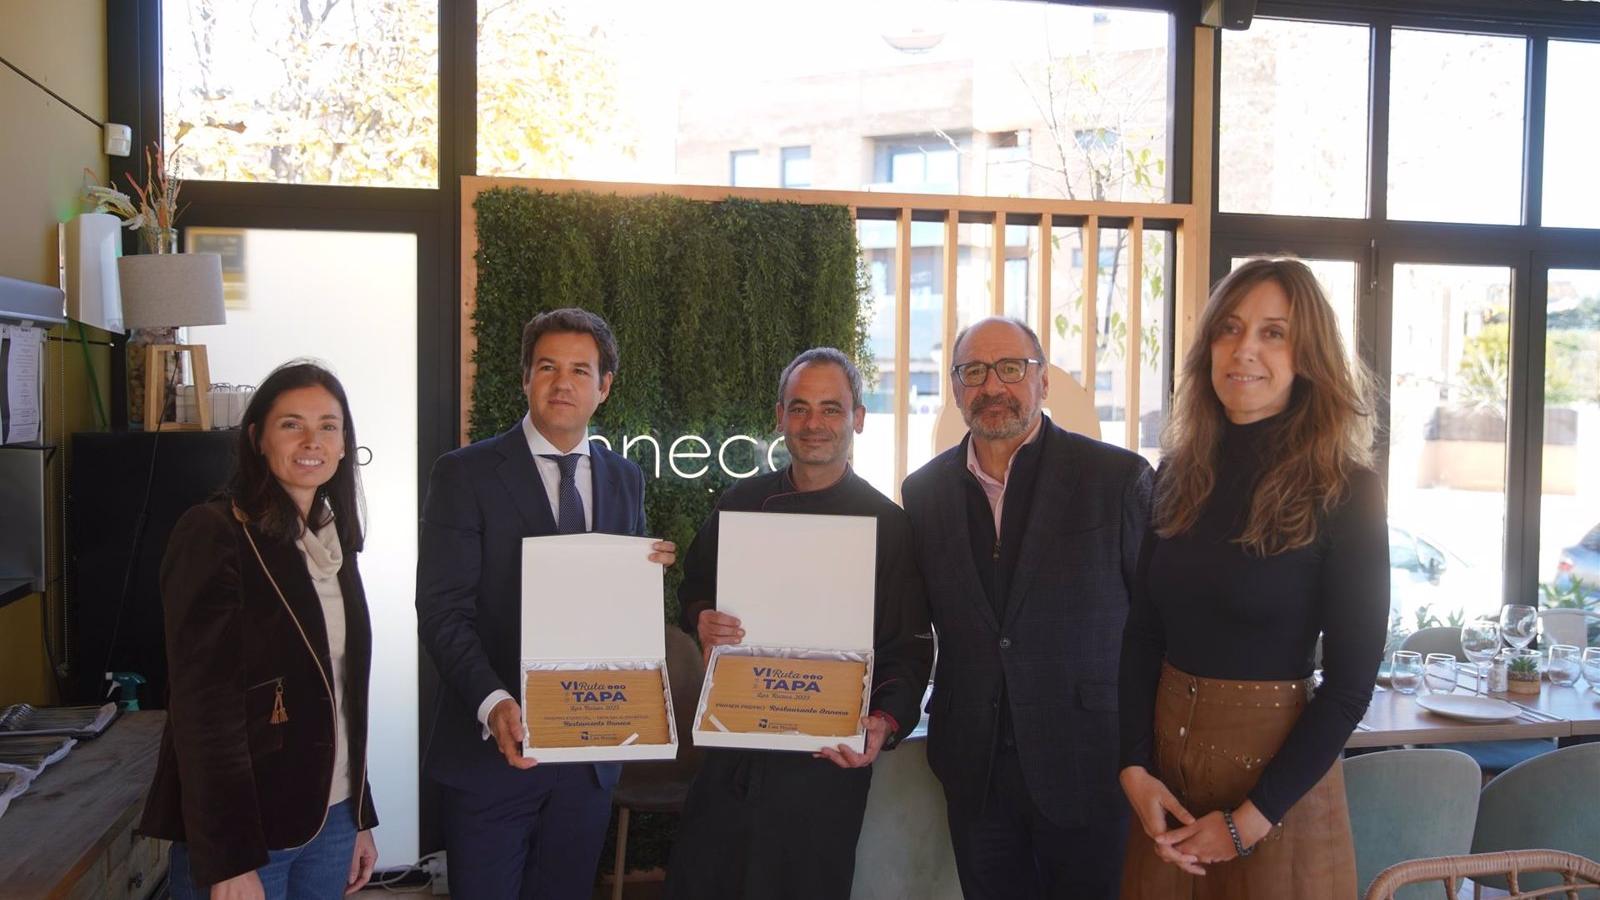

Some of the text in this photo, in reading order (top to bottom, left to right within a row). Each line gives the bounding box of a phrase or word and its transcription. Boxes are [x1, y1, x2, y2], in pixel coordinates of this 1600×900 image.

[753, 667, 800, 680] VI Ruta
[561, 681, 605, 691] VI Ruta
[763, 678, 821, 692] TAPA
[572, 691, 627, 702] TAPA
